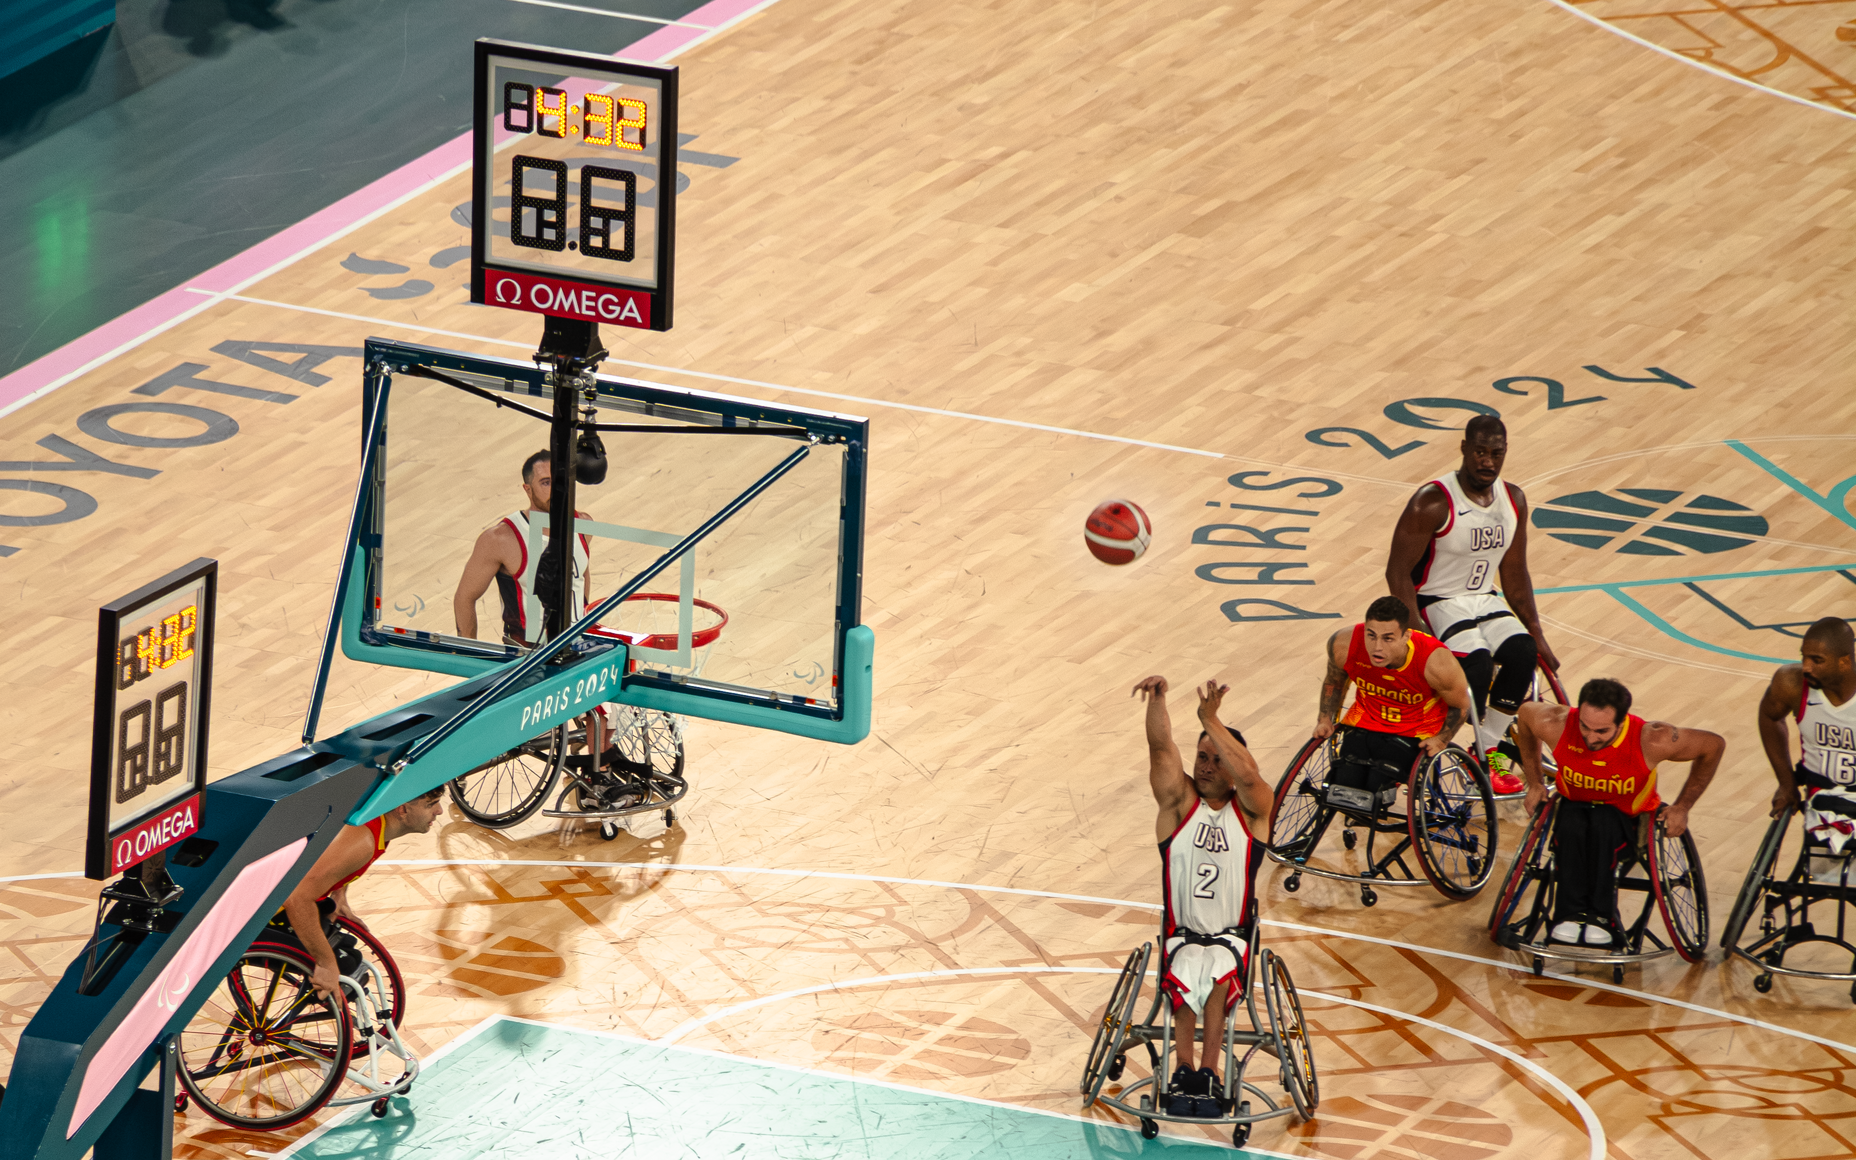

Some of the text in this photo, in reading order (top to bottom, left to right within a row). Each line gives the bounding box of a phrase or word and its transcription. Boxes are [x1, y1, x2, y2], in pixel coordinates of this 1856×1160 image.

[530, 283, 642, 324] OMEGA
[1305, 364, 1697, 460] 2024
[0, 340, 366, 558] OYOTA
[1470, 525, 1504, 551] USA
[1466, 560, 1489, 590] 8
[574, 664, 619, 705] 2024
[1814, 722, 1855, 749] USA
[1563, 765, 1636, 795] ESPAÑA
[1818, 750, 1856, 784] 16
[135, 806, 195, 857] OMEGA
[1193, 822, 1229, 852] USA
[1193, 863, 1219, 899] 2
